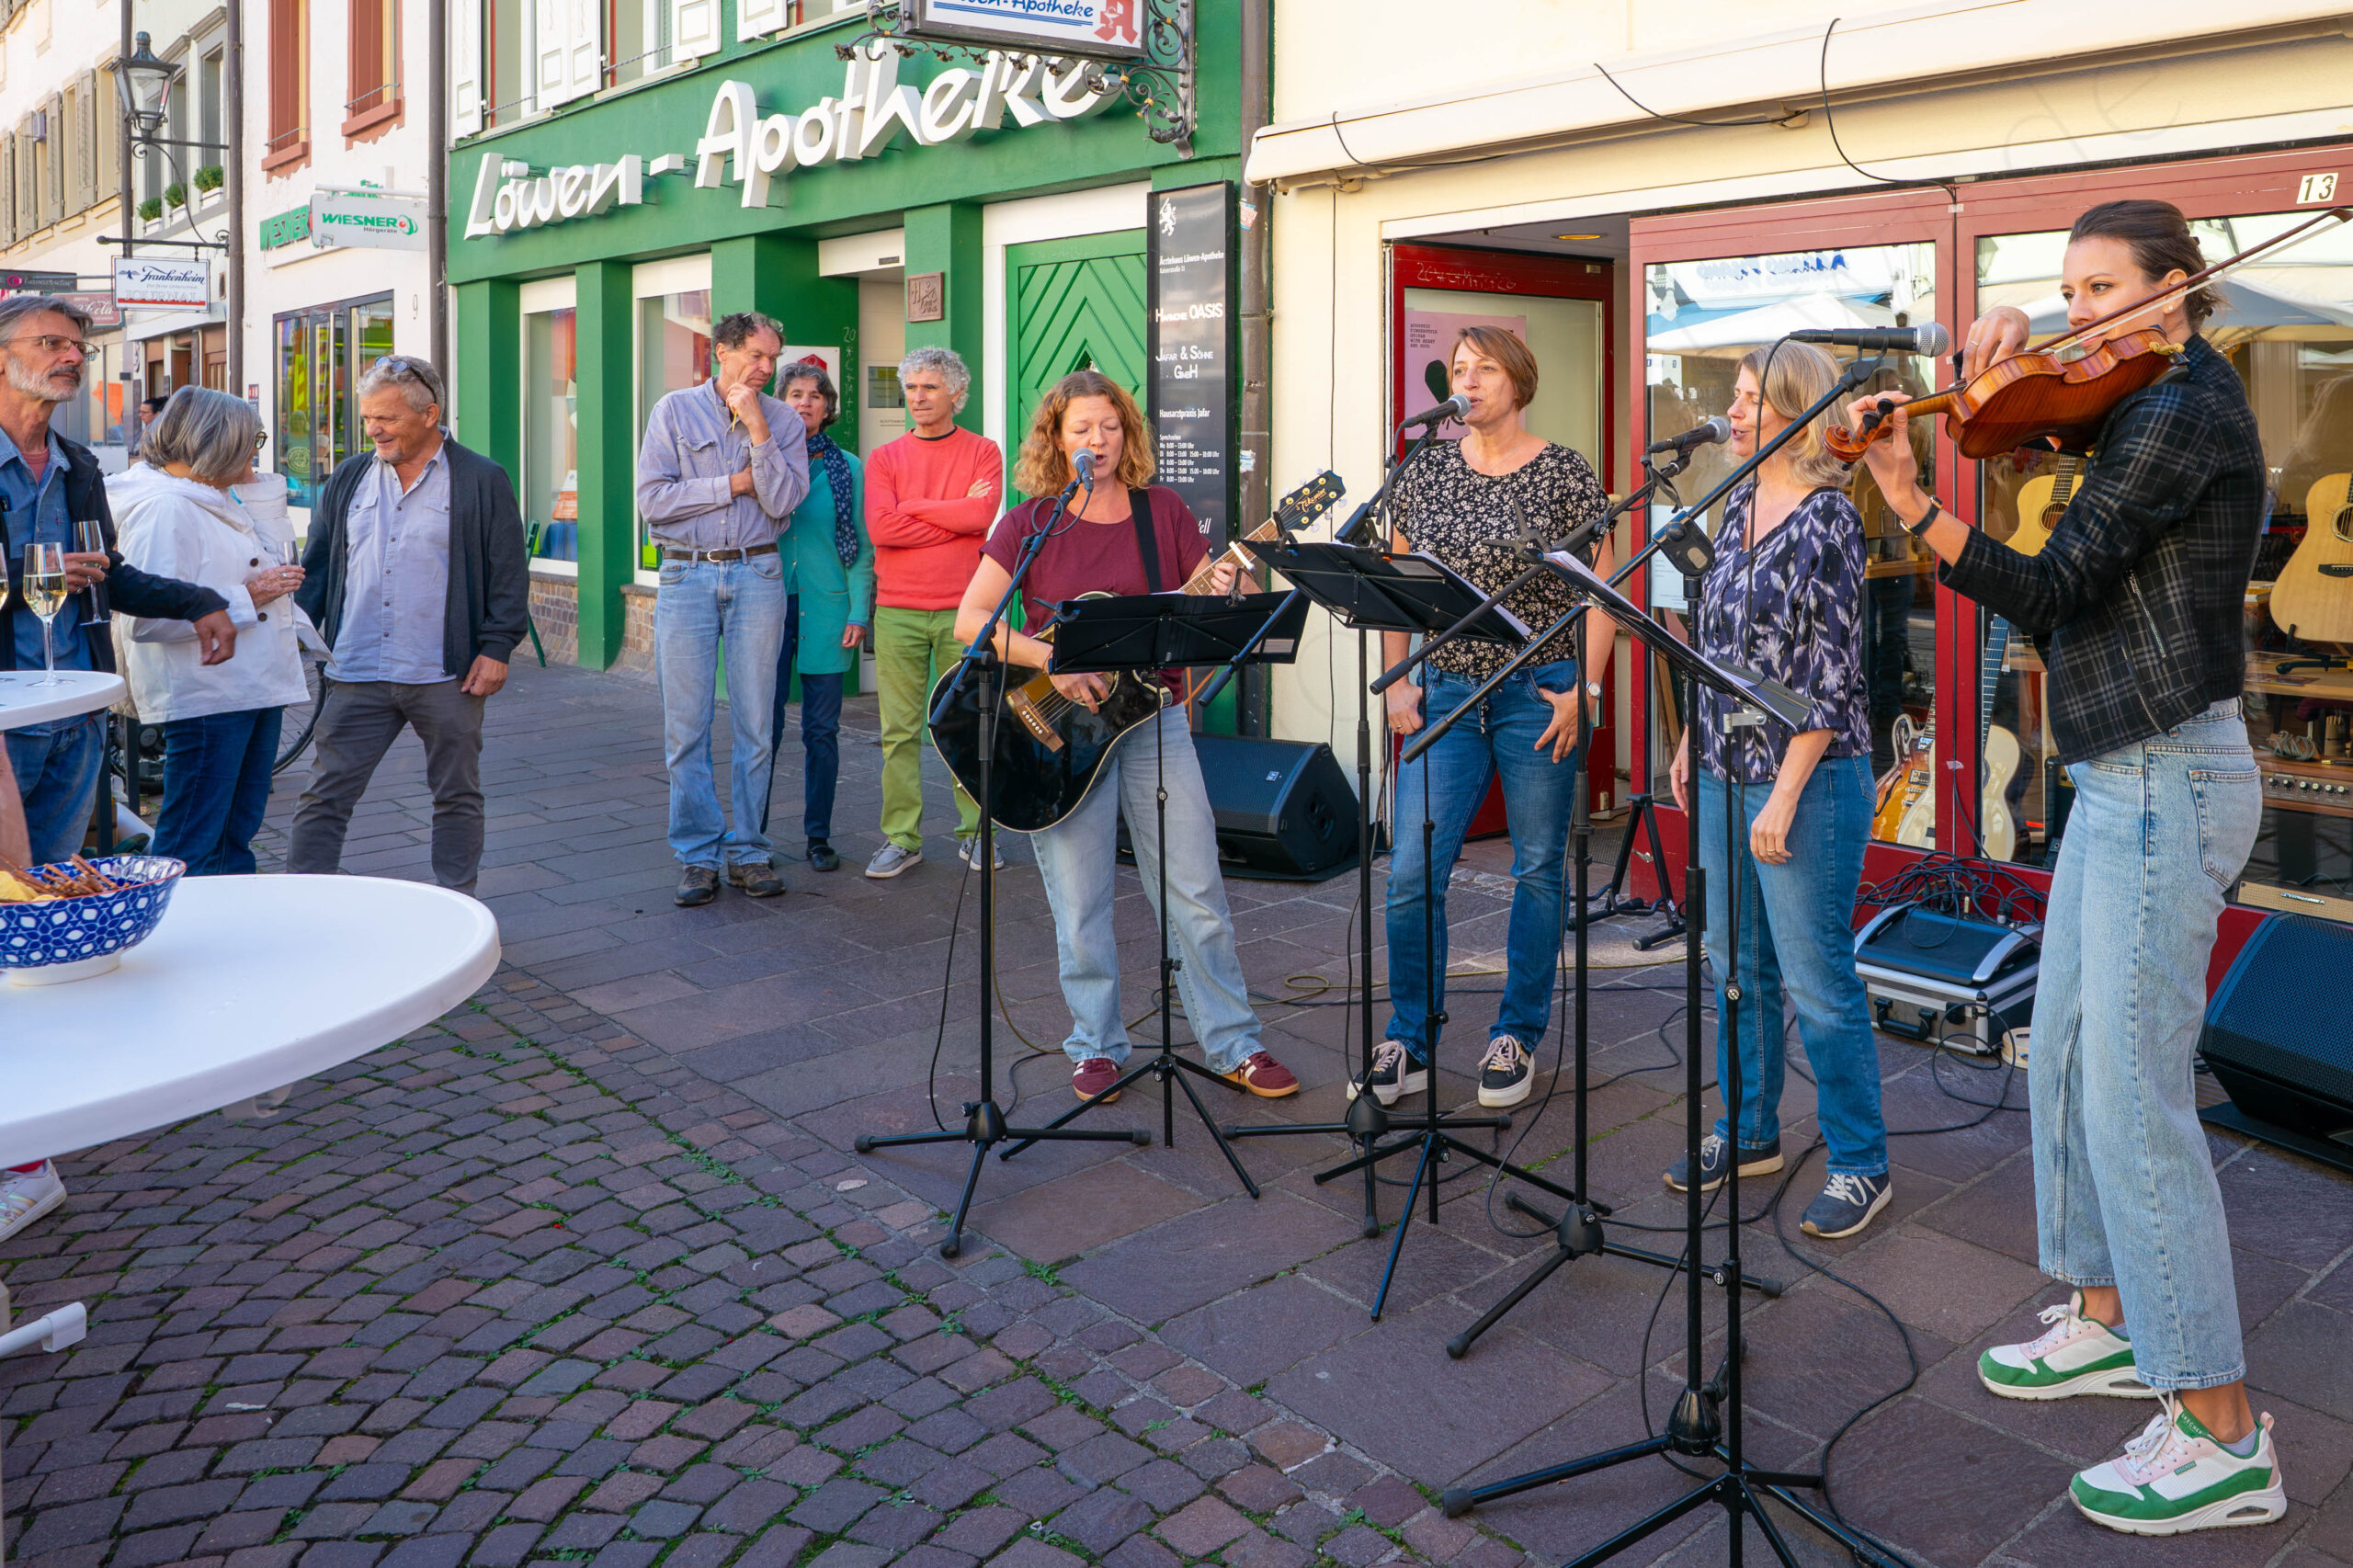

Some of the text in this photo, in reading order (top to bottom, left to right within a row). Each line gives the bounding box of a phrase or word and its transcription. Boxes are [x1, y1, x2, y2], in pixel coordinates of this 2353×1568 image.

[2304, 175, 2335, 201] 13
[259, 204, 311, 252] WIESNER
[322, 212, 398, 228] WIESNER
[141, 265, 205, 285] Frankenheim
[1188, 302, 1223, 320] OASIS
[1180, 346, 1188, 360] &
[1189, 345, 1214, 360] SÖHNE
[1159, 407, 1211, 420] Hausarztpraxis Jafar
